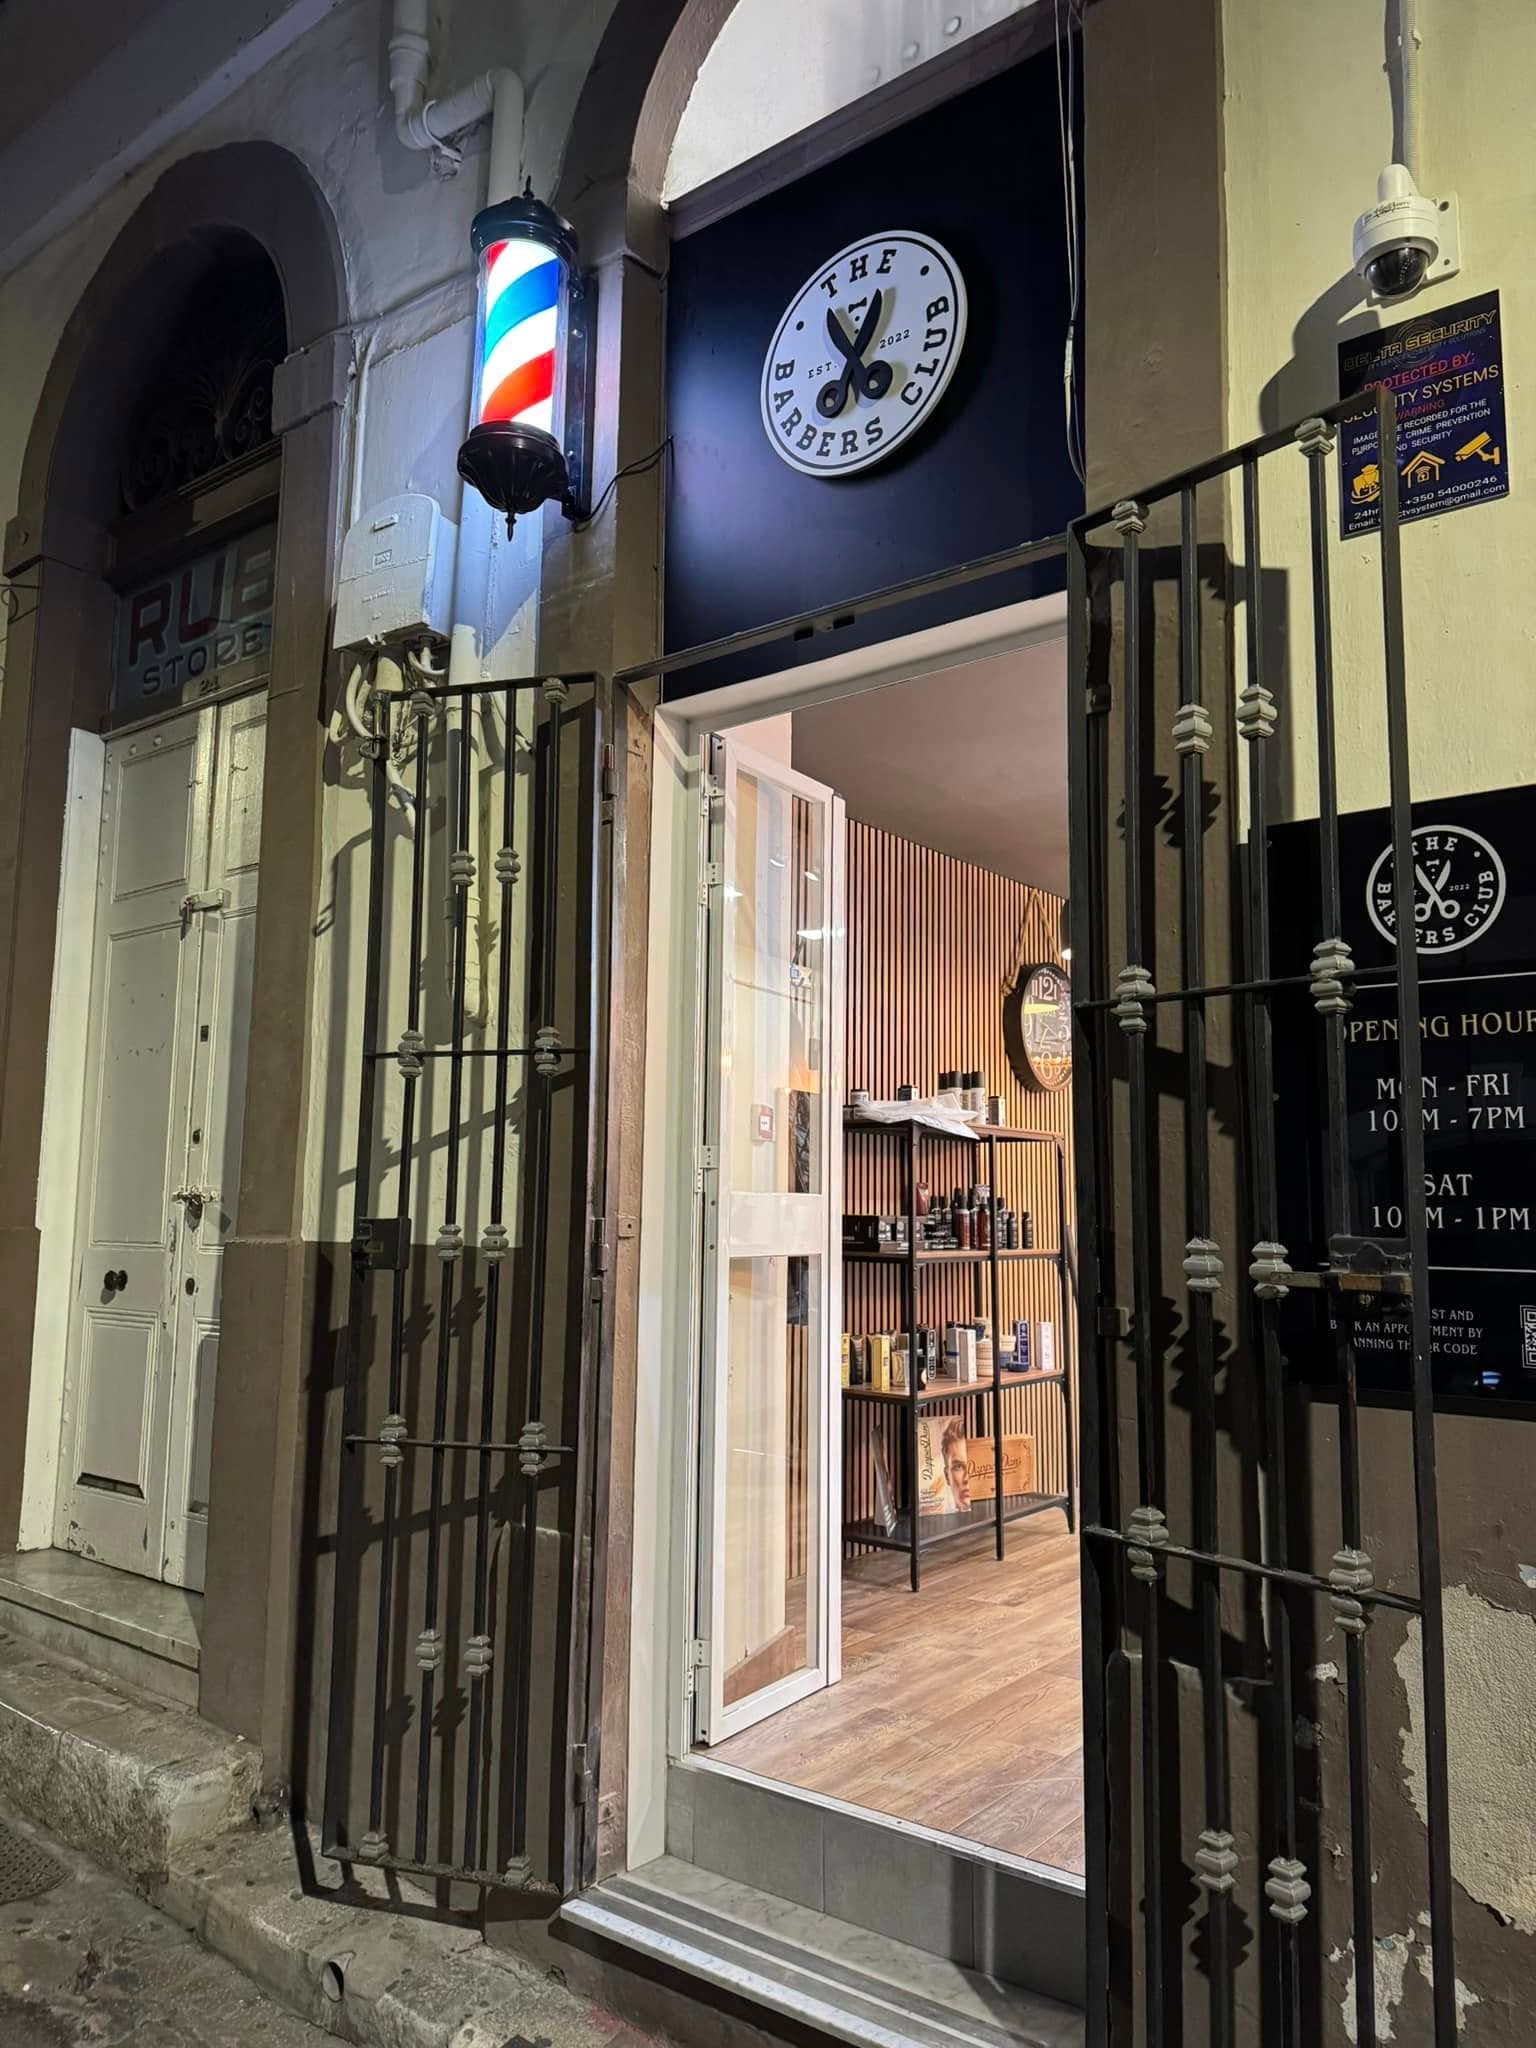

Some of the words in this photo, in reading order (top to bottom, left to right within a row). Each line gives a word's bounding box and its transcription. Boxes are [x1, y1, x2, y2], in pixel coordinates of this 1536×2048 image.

[821, 249, 897, 298] THE
[879, 329, 910, 349] 2022
[1406, 309, 1497, 351] SECURITY
[900, 296, 949, 406] CLUB
[808, 362, 838, 379] EST.
[1422, 364, 1500, 399] SYSTEMS
[774, 359, 884, 457] BARBERS
[1404, 410, 1448, 429] RECORDED
[1451, 404, 1467, 416] FOR
[1470, 398, 1487, 410] THE
[1406, 425, 1432, 440] CRIME
[1435, 408, 1491, 431] PREVENTION
[1411, 430, 1453, 447] SECURITY
[1405, 491, 1435, 506] +350
[1437, 475, 1498, 497] 54000246
[1449, 883, 1470, 892] 2022
[1464, 870, 1495, 928] CLUB
[1377, 882, 1456, 945] BARERS
[1343, 1016, 1449, 1042] PENNG
[1376, 1076, 1438, 1100] MN
[1466, 1072, 1510, 1097] FRI
[1368, 1108, 1441, 1132] 10M
[1468, 1106, 1526, 1130] 7PM
[1424, 1173, 1473, 1196] SAT
[1372, 1205, 1444, 1229] 10M
[1476, 1206, 1531, 1231] 1PM
[1329, 1319, 1362, 1332] BK
[1364, 1322, 1380, 1333] AN
[1468, 1326, 1484, 1338] BY
[1450, 1310, 1474, 1322] AND
[1443, 1342, 1478, 1355] CODE
